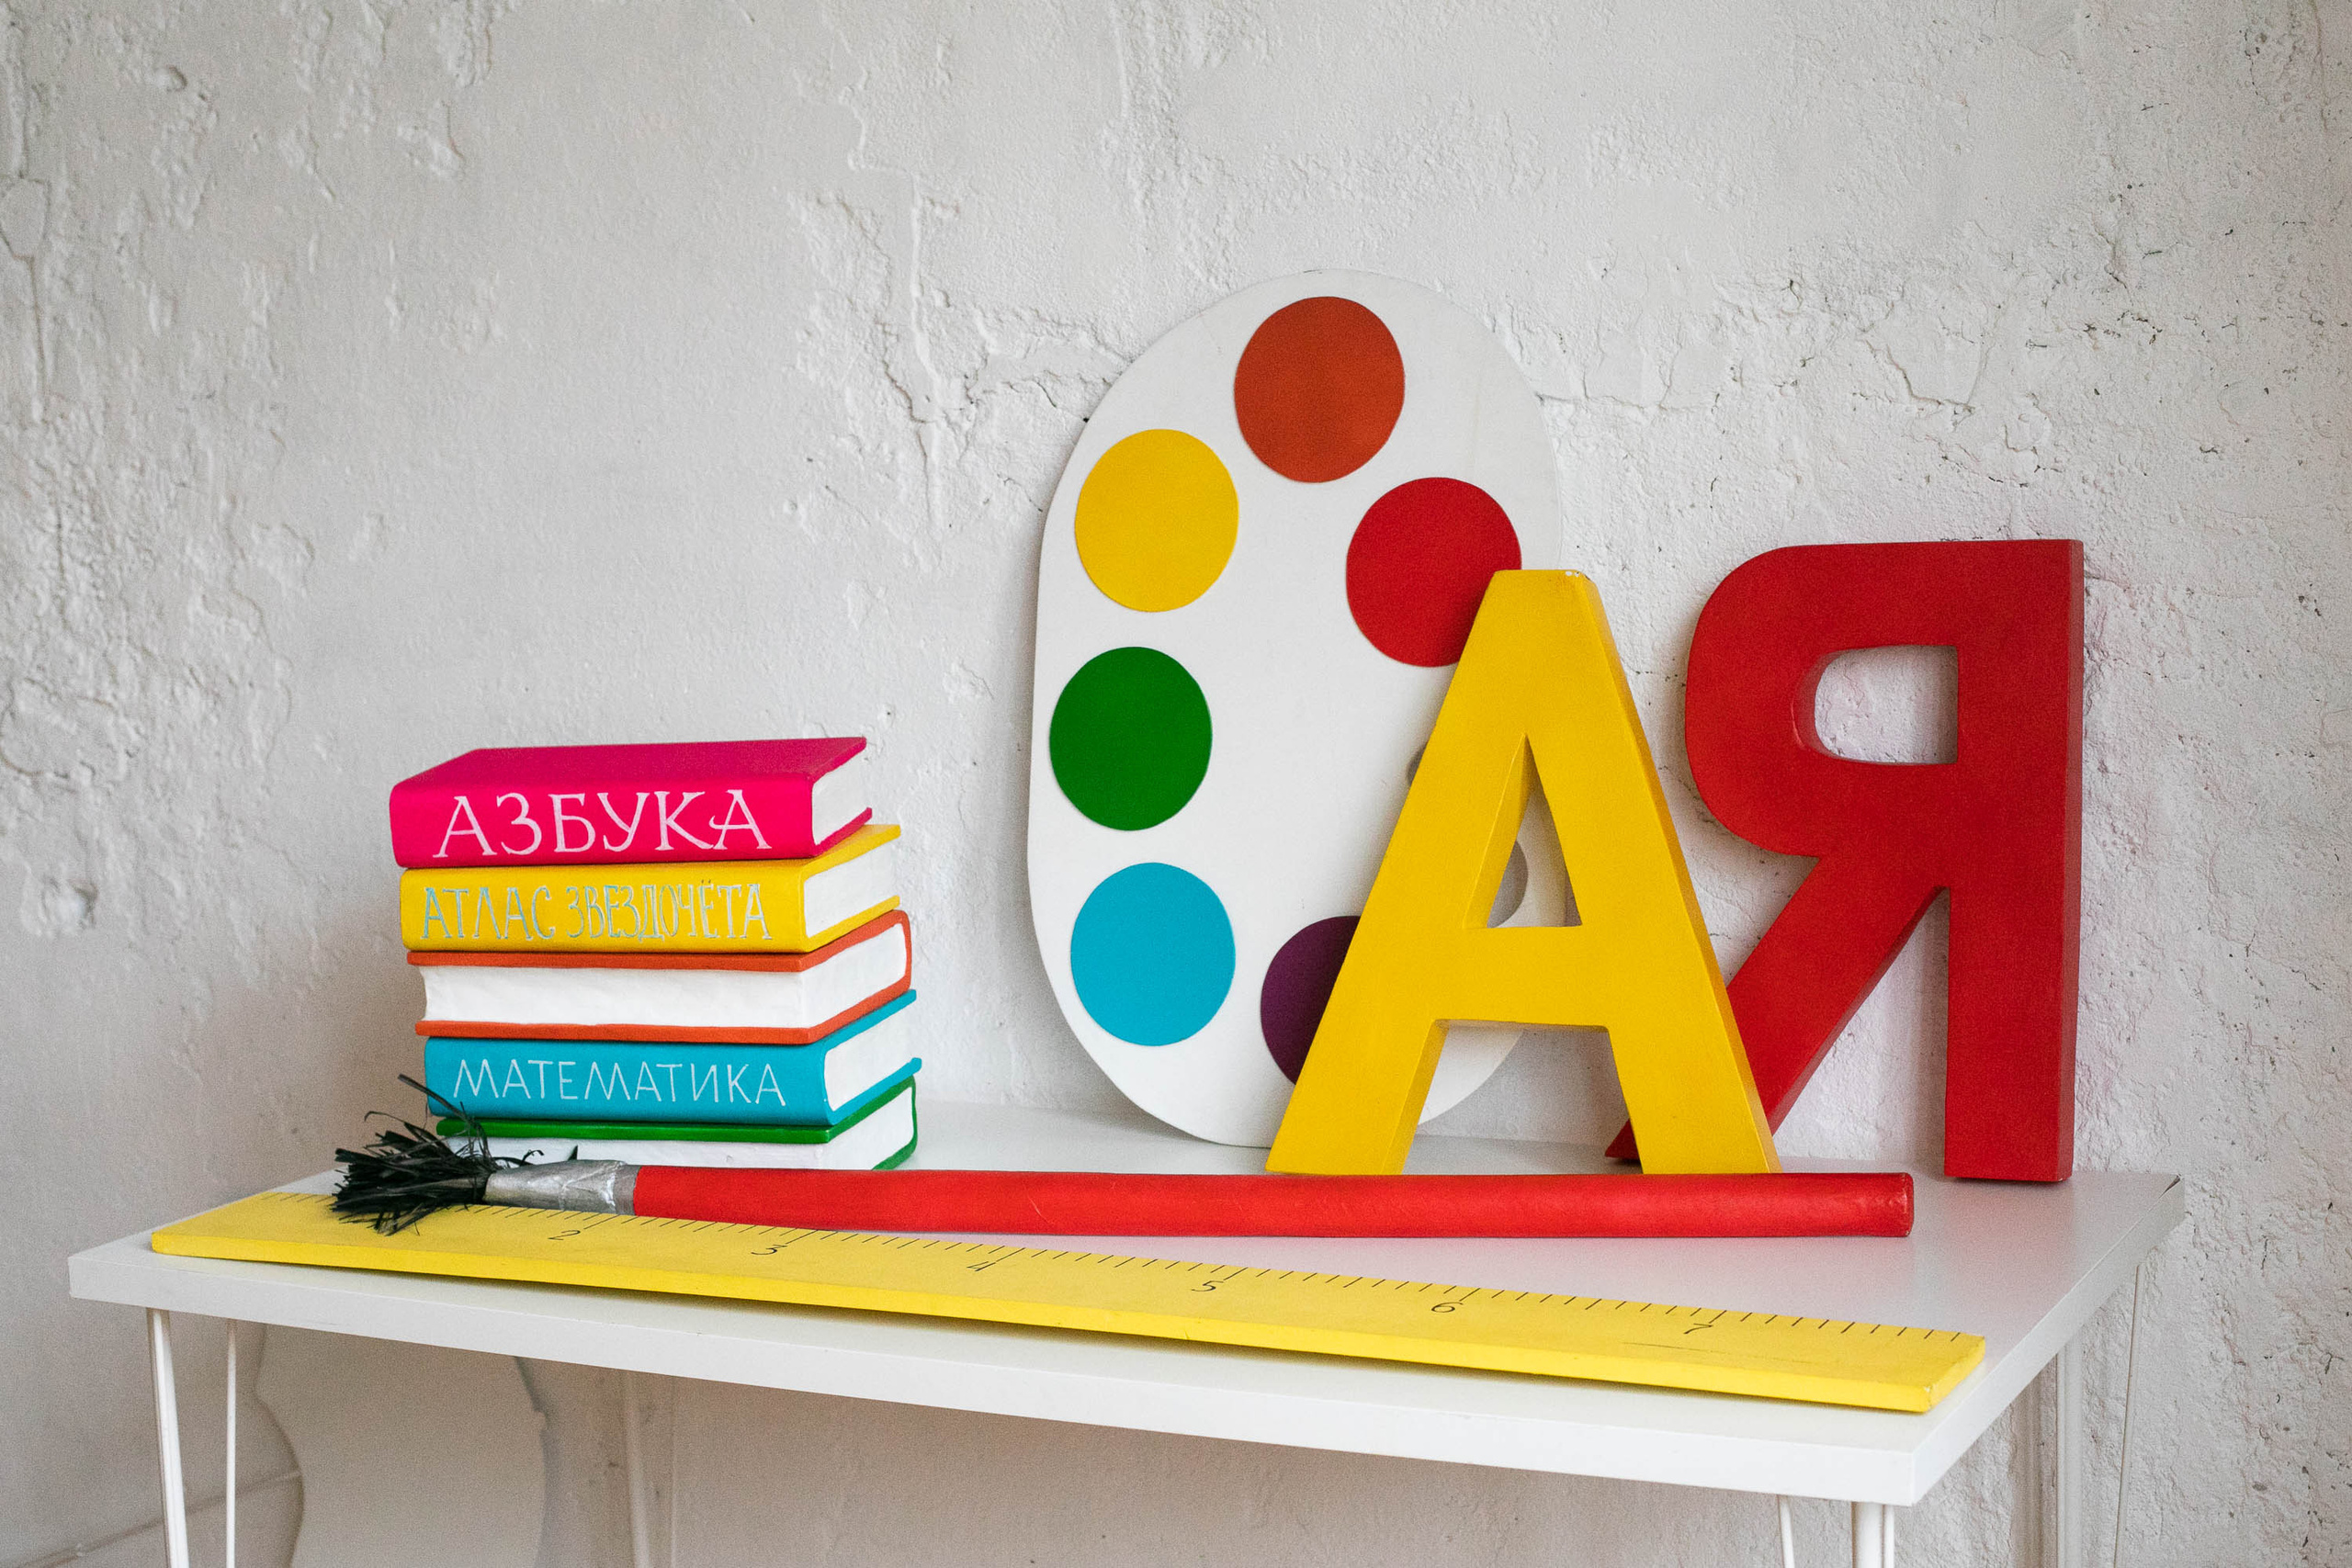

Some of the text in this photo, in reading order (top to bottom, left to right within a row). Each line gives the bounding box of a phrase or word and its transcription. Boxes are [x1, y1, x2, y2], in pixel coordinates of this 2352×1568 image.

[433, 790, 771, 857] АЗБУКА
[1265, 540, 2084, 1180] А Я
[421, 879, 773, 942] АТЛАС ЗВЕЗДОЧЁТА
[453, 1059, 786, 1106] МАТЕМАТИКА
[548, 1230, 1713, 1334] 2 3 4 5 6 7
